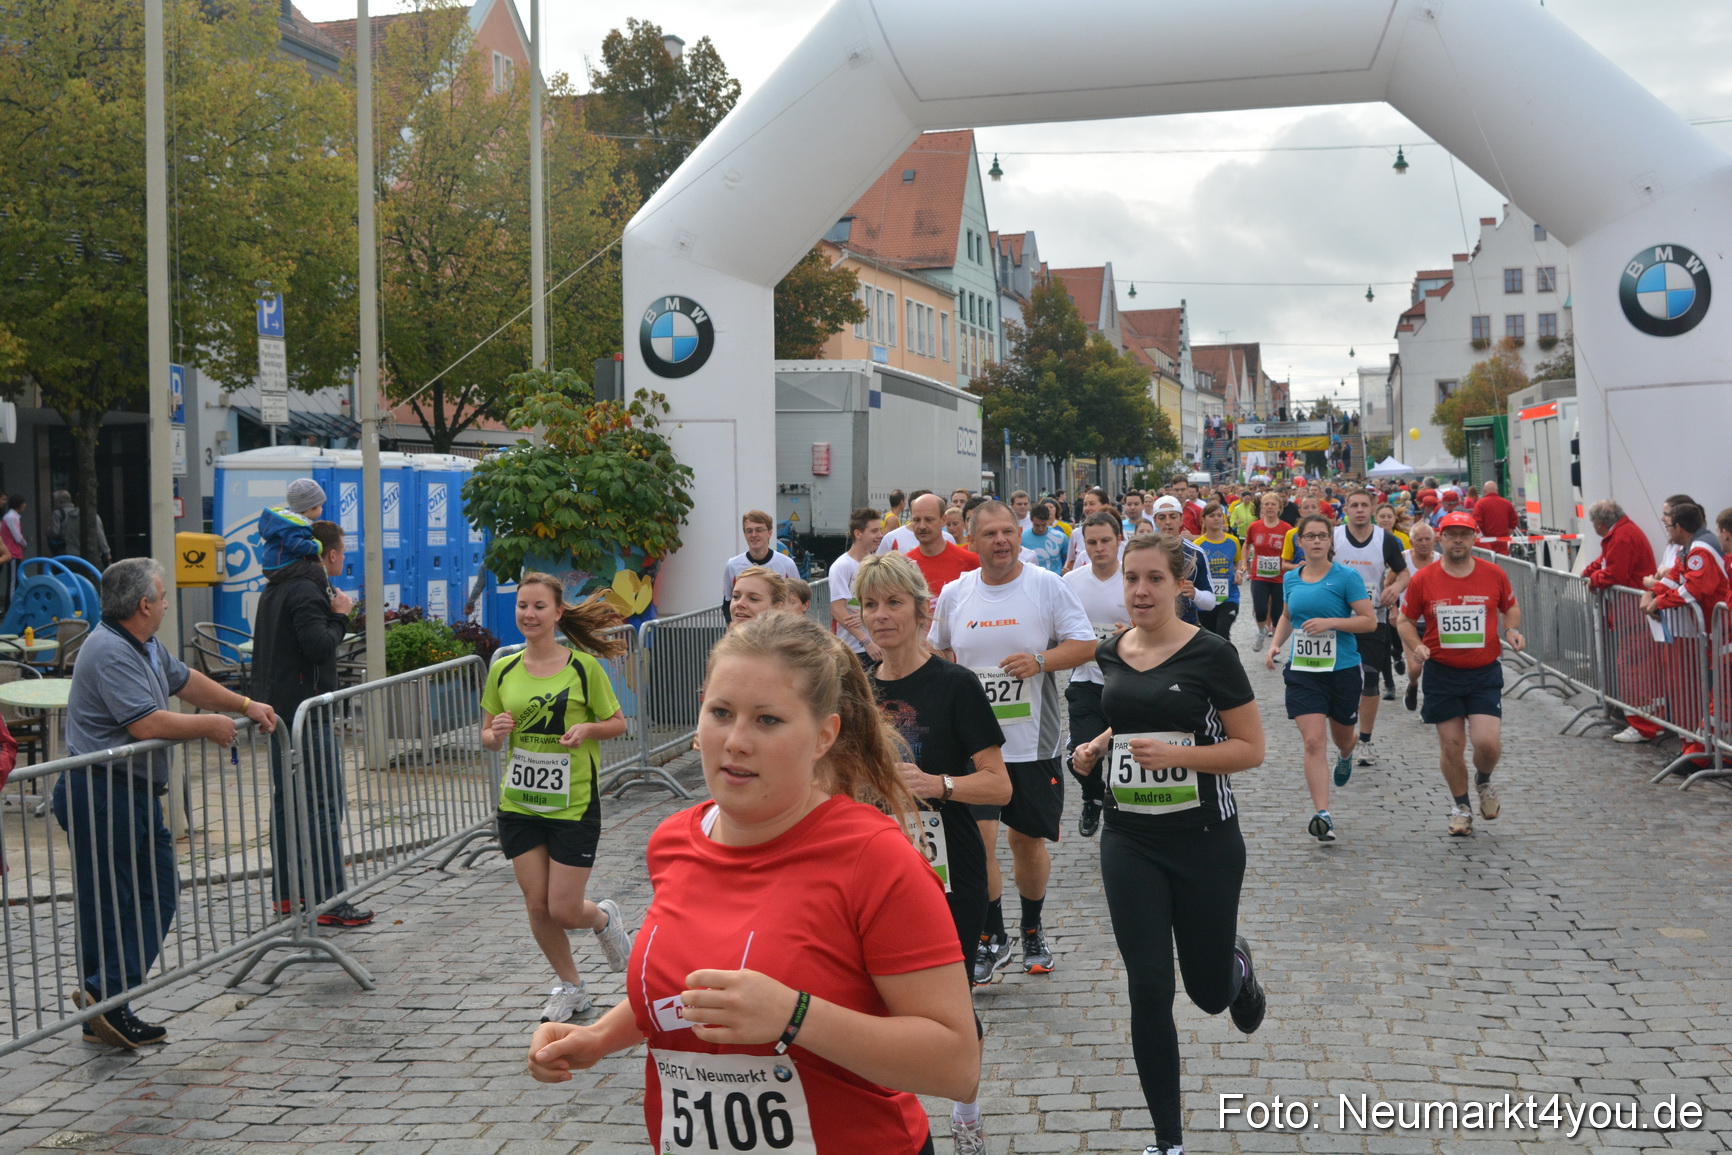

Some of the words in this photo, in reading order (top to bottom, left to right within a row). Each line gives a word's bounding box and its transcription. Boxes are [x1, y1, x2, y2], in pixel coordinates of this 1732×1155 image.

[1626, 246, 1704, 279] BMW
[263, 291, 277, 328] P
[644, 297, 708, 324] BMW
[1267, 439, 1299, 448] START
[205, 447, 213, 466] 3
[340, 487, 357, 513] DIXI
[383, 487, 400, 511] DIXI
[429, 487, 446, 509] DIXI
[1259, 561, 1278, 570] 5132
[1214, 585, 1226, 595] 22
[980, 618, 1020, 627] KLEBL
[1442, 616, 1479, 632] 5551
[1297, 640, 1332, 656] 5014
[984, 680, 1024, 703] 527
[512, 753, 527, 763] PARTL
[527, 755, 559, 766] Neumarkt
[512, 763, 563, 791] 5023
[523, 793, 547, 805] Nadja
[1134, 791, 1172, 803] Andrea
[658, 1062, 695, 1081] PARTL
[695, 1068, 768, 1083] Neumarkt
[672, 1088, 794, 1151] 5106
